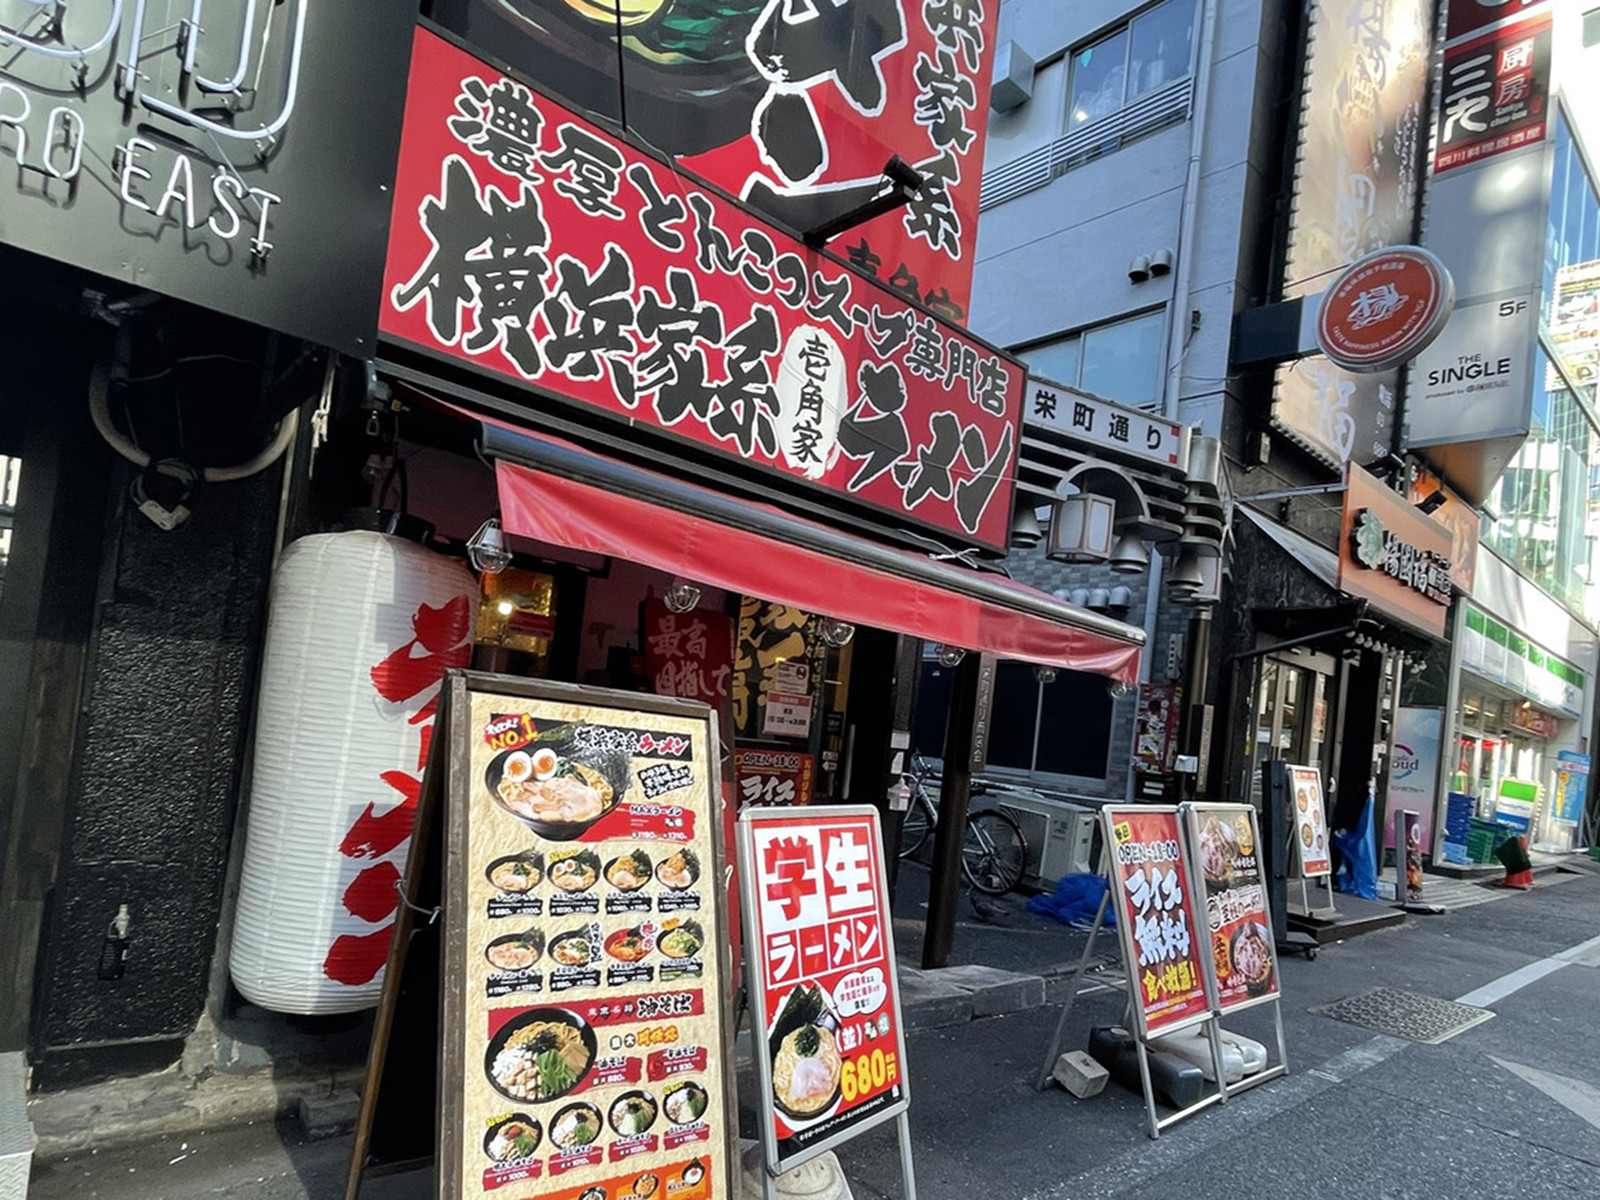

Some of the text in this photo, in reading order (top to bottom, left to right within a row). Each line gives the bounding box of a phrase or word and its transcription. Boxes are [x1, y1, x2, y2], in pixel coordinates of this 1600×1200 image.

[121, 138, 281, 255] EAST
[1498, 300, 1527, 317] 5F
[1428, 358, 1511, 386] SINGLE
[1458, 353, 1481, 365] THE
[789, 332, 832, 466] 壱角家
[1034, 389, 1162, 450] 栄町通り
[648, 614, 707, 660] 最高
[740, 775, 796, 803] ライス
[763, 831, 875, 922] 学生
[1124, 867, 1183, 917] ライス
[768, 922, 879, 982] ラーメン
[1134, 908, 1191, 967] 無料
[637, 993, 694, 1019] 油そば
